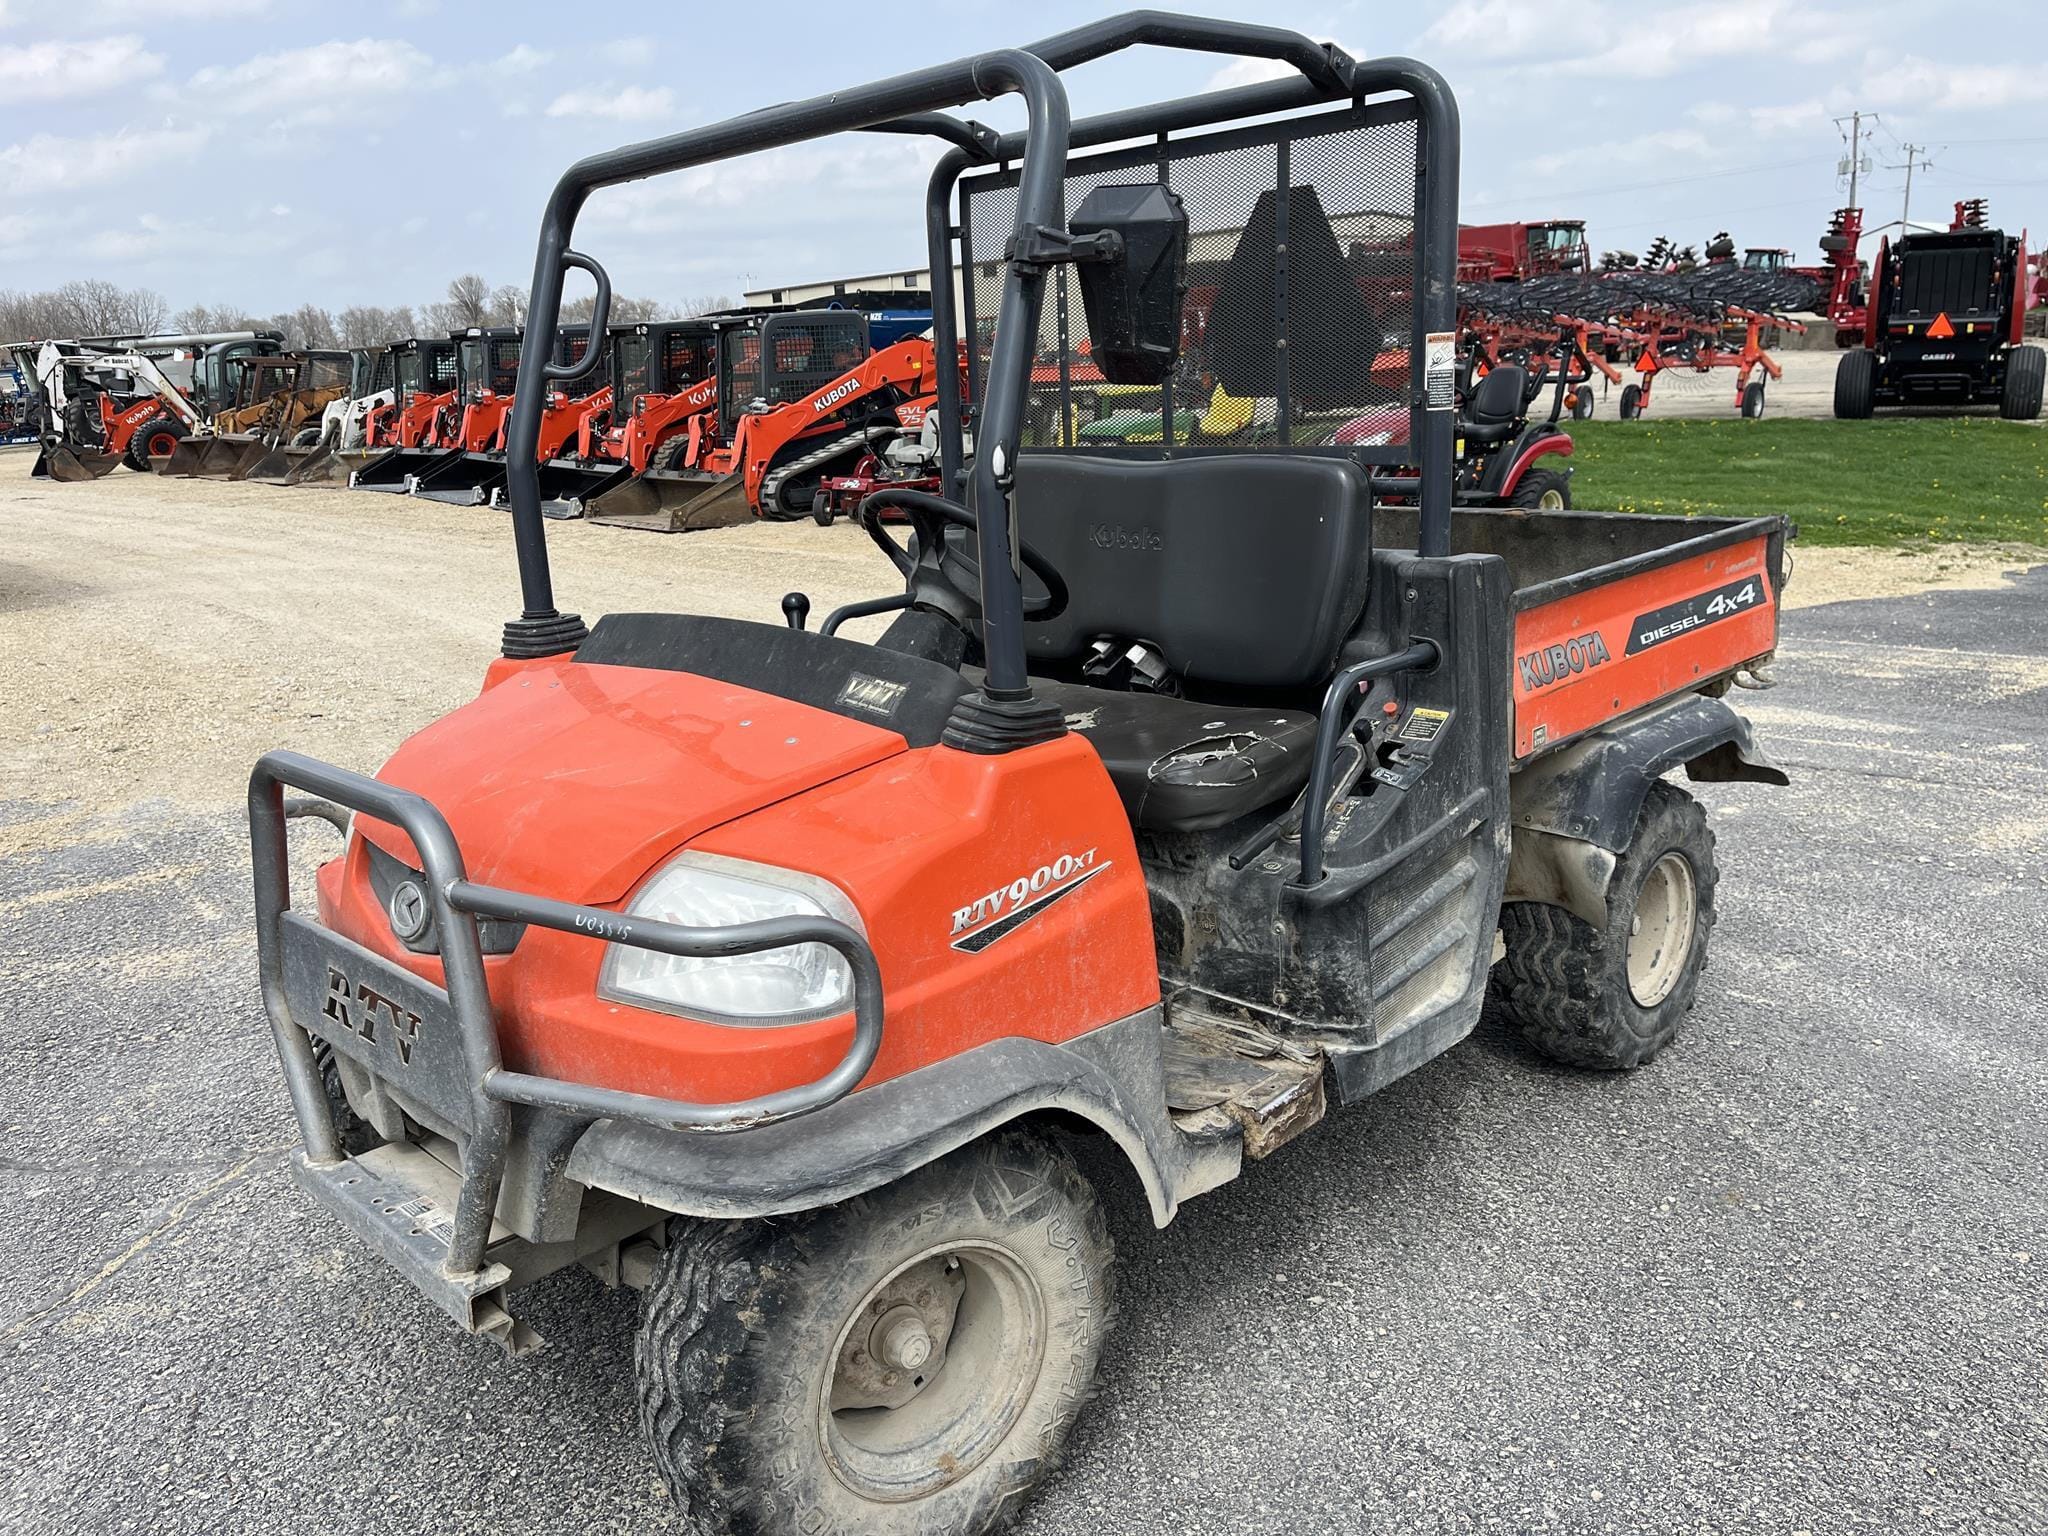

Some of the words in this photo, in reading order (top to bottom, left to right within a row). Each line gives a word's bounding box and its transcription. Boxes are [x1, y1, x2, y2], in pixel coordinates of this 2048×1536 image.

[813, 378, 861, 413] KUBOTA
[897, 406, 926, 415] SVL
[125, 405, 154, 425] Kubota
[1089, 523, 1162, 551] Kubota
[1640, 615, 1706, 645] DIESEL
[1705, 583, 1756, 616] 4x4
[1518, 630, 1611, 692] KUBOTA
[322, 966, 422, 1067] RTV
